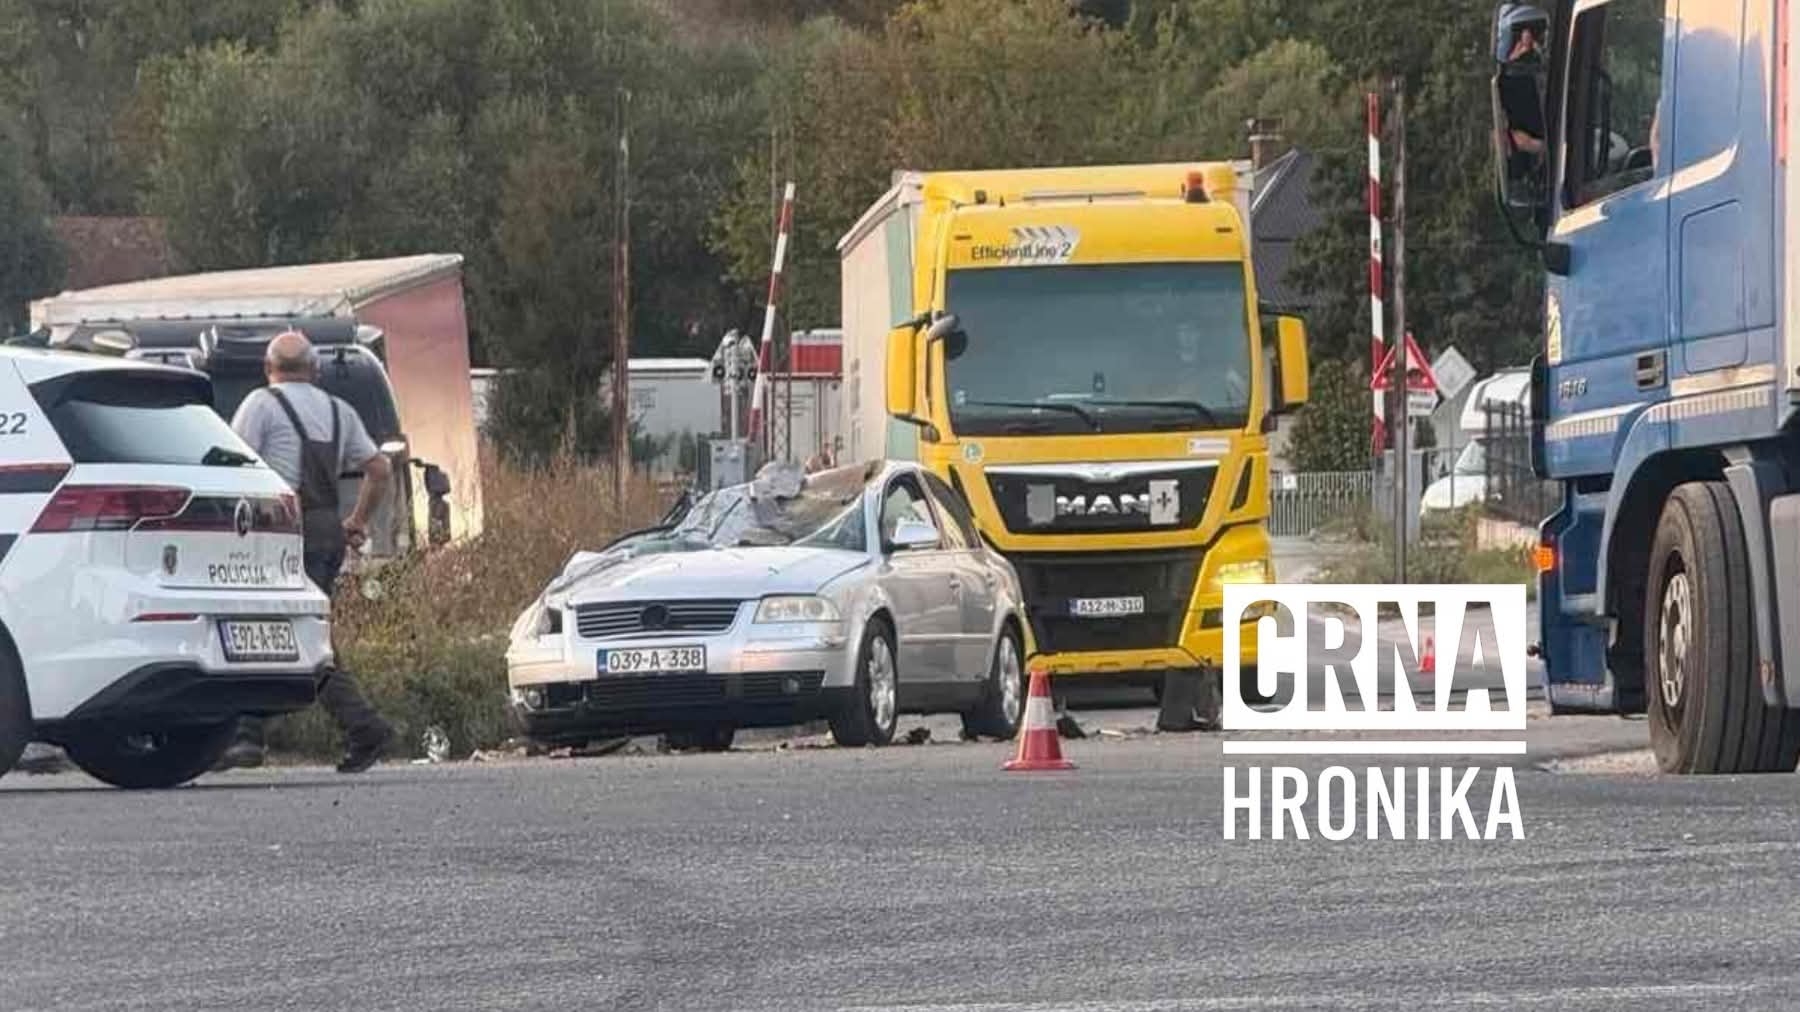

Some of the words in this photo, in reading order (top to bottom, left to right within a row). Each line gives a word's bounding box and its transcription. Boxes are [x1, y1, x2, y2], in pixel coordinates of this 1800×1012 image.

[971, 244, 1057, 261] EfficientLine
[1060, 241, 1071, 256] 2
[1056, 493, 1150, 515] MAN
[208, 563, 267, 584] POLICIJA
[230, 622, 294, 650] E92-A-852
[610, 649, 701, 670] 039-A-338
